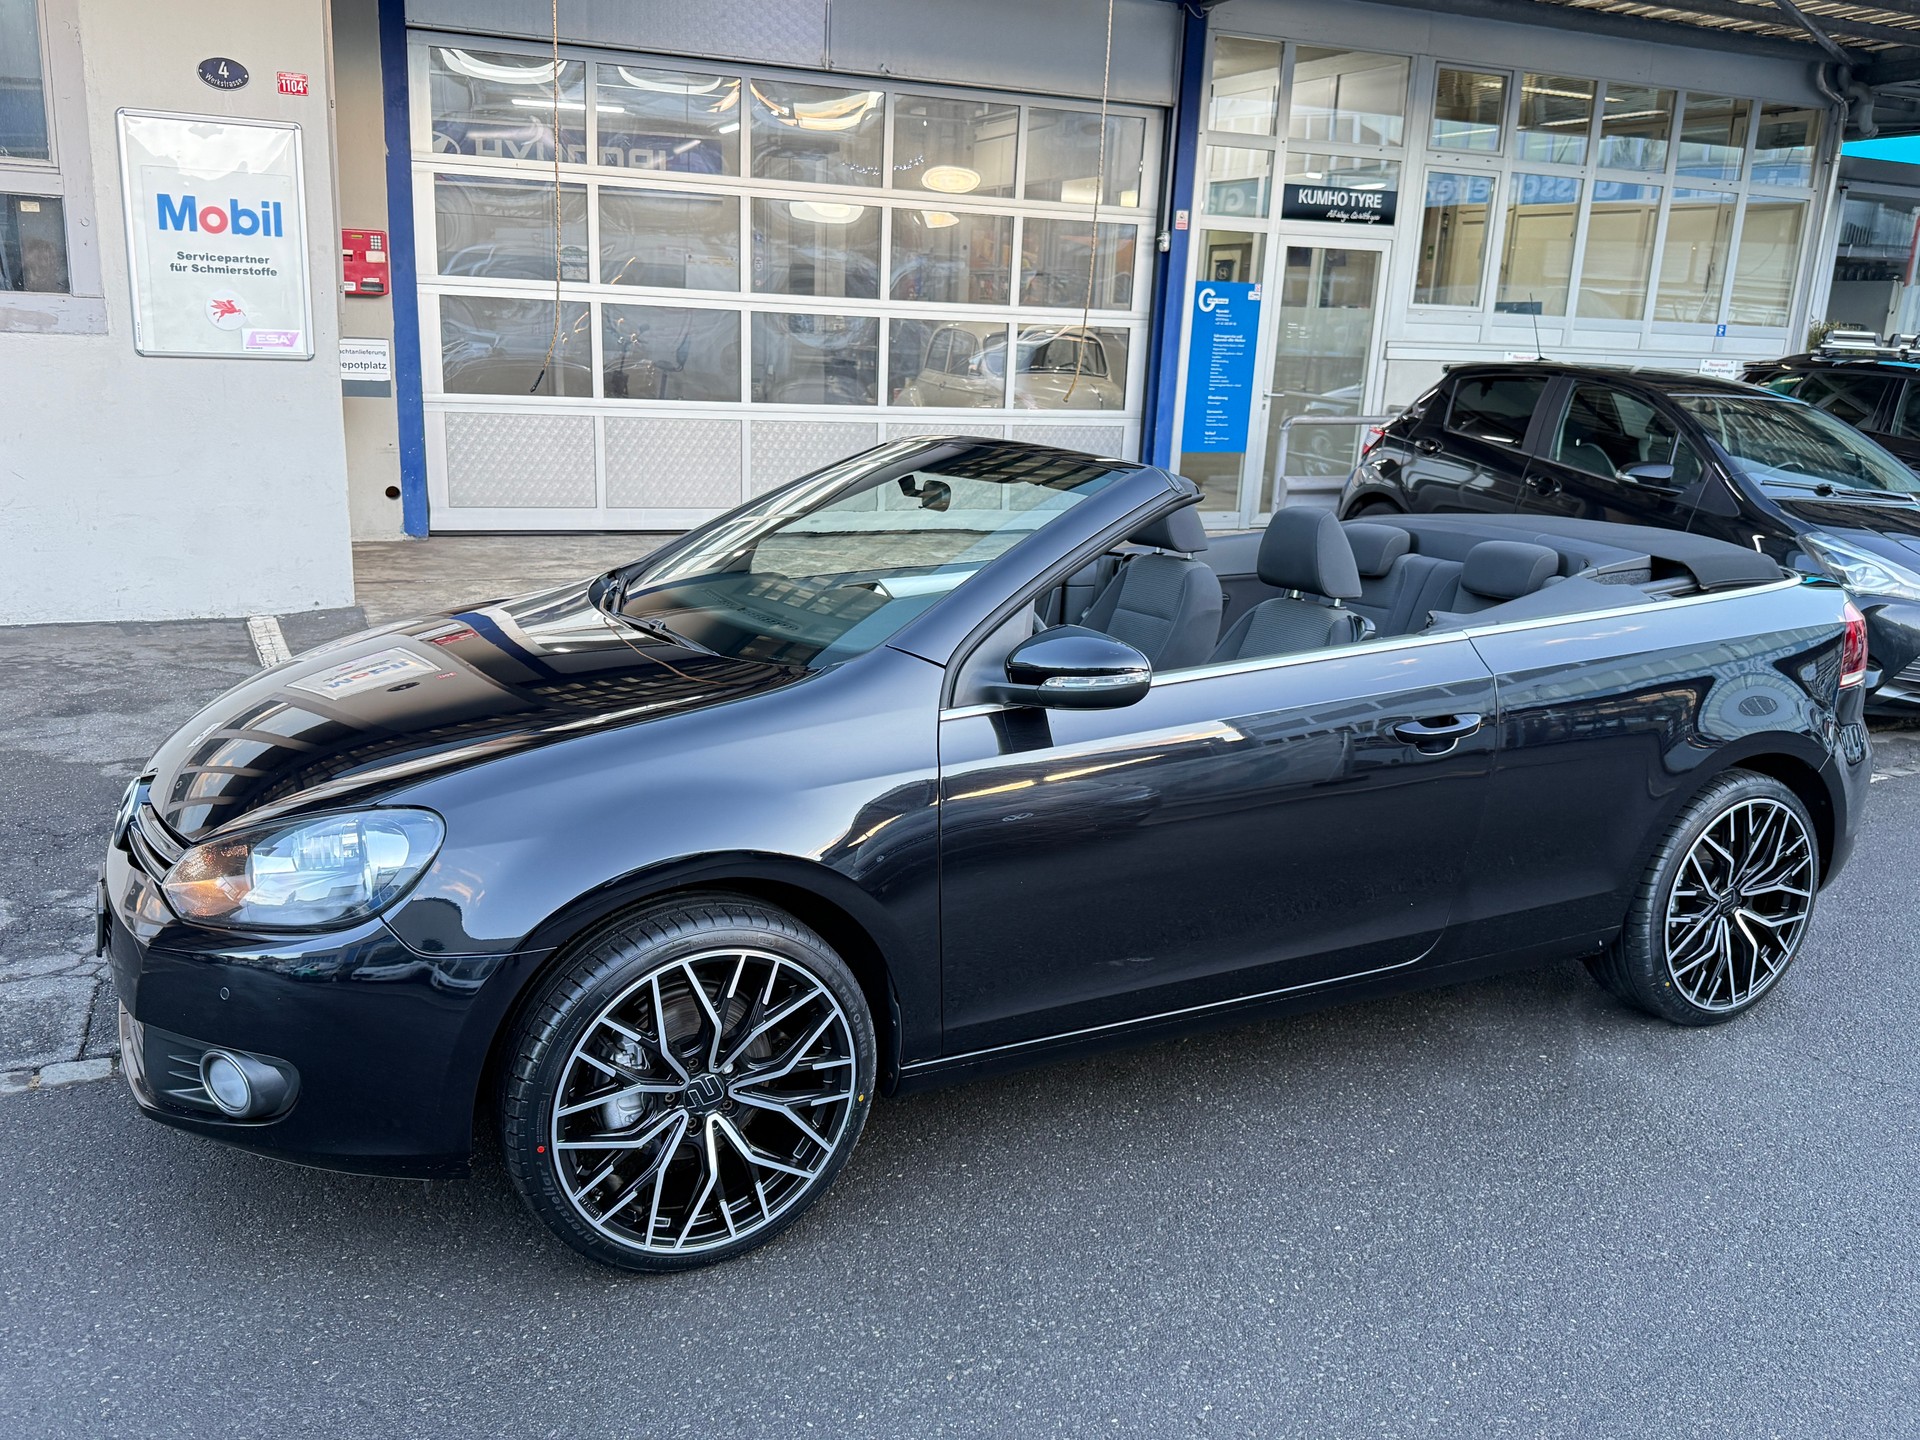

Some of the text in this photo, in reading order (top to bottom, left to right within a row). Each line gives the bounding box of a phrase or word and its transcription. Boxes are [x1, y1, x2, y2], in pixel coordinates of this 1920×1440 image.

[218, 61, 229, 79] 4
[205, 72, 244, 88] Werkstrasse
[281, 80, 304, 93] 1104
[1298, 188, 1383, 209] KUMHO TYRE
[156, 193, 283, 238] Mobil
[176, 251, 270, 265] Servicepartner
[169, 262, 278, 277] für Schmierstoffe
[340, 349, 387, 357] chtanlieferung
[340, 361, 388, 371] epotplatz
[541, 1169, 599, 1246] Interstellar
